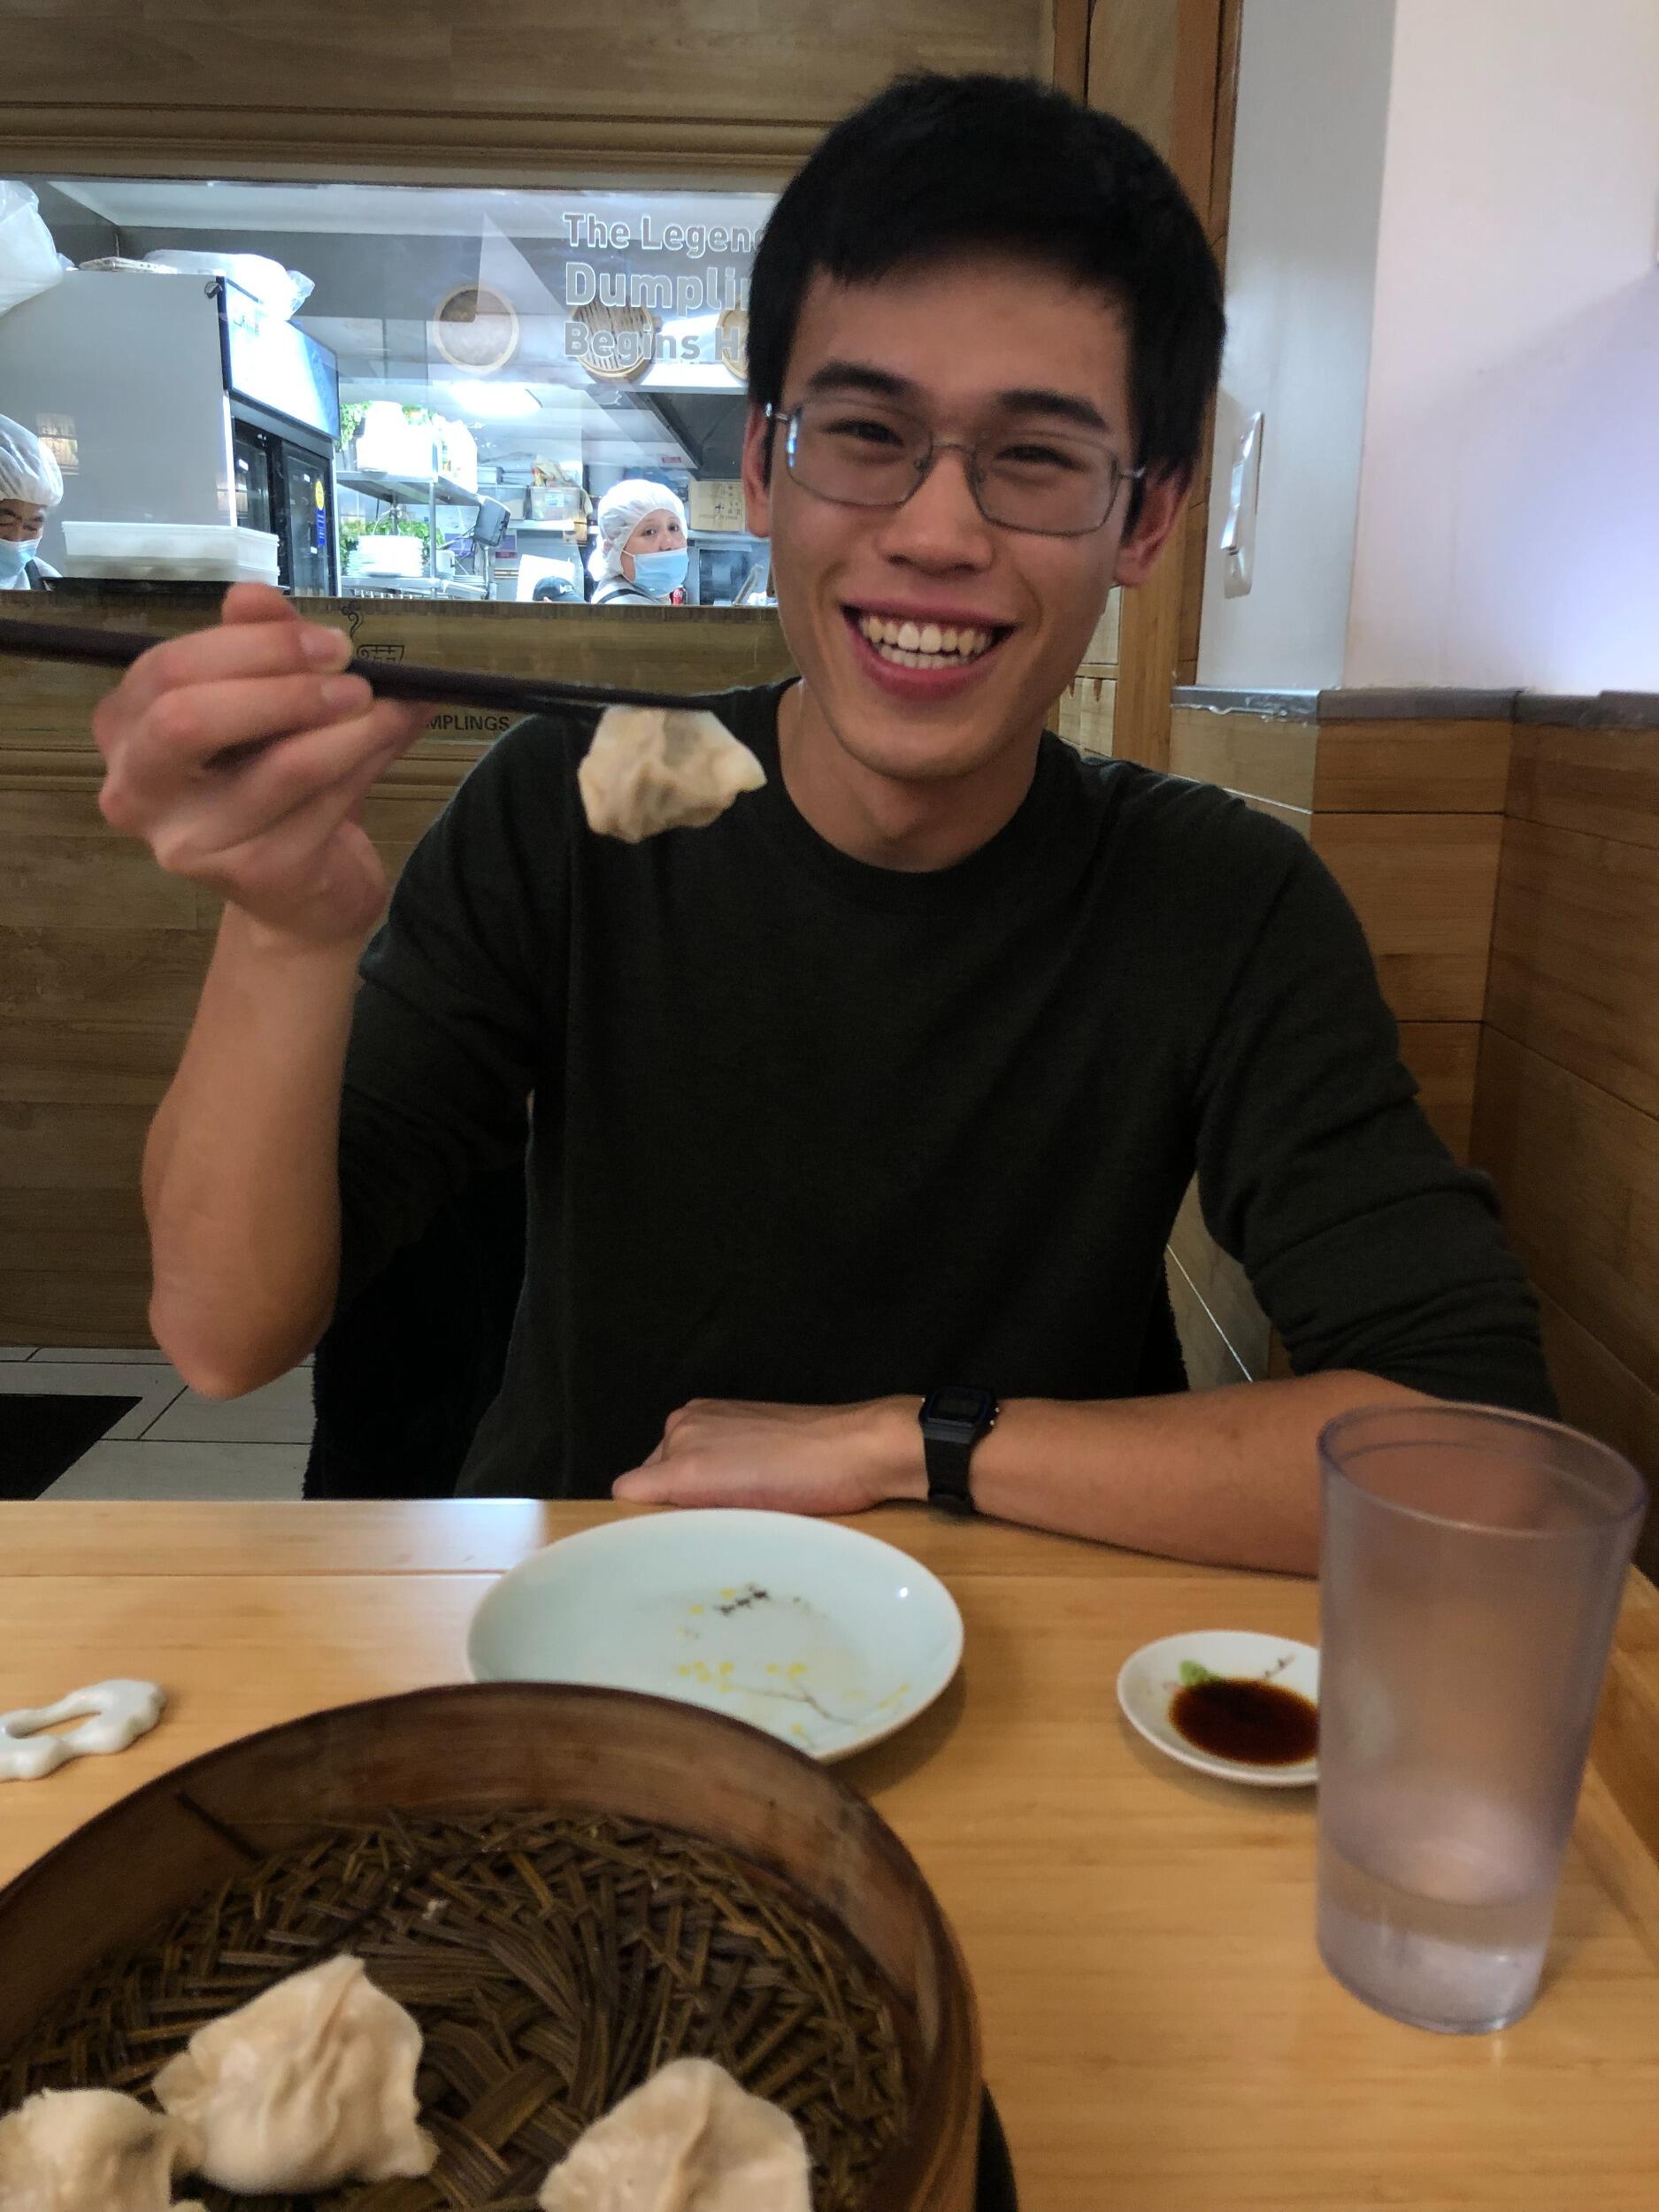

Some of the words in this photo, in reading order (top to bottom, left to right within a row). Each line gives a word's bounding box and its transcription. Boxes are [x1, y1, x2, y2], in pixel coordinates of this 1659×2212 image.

[563, 211, 630, 249] The
[565, 320, 701, 366] Begins
[714, 326, 748, 362] H
[426, 714, 510, 732] MPLINGS
